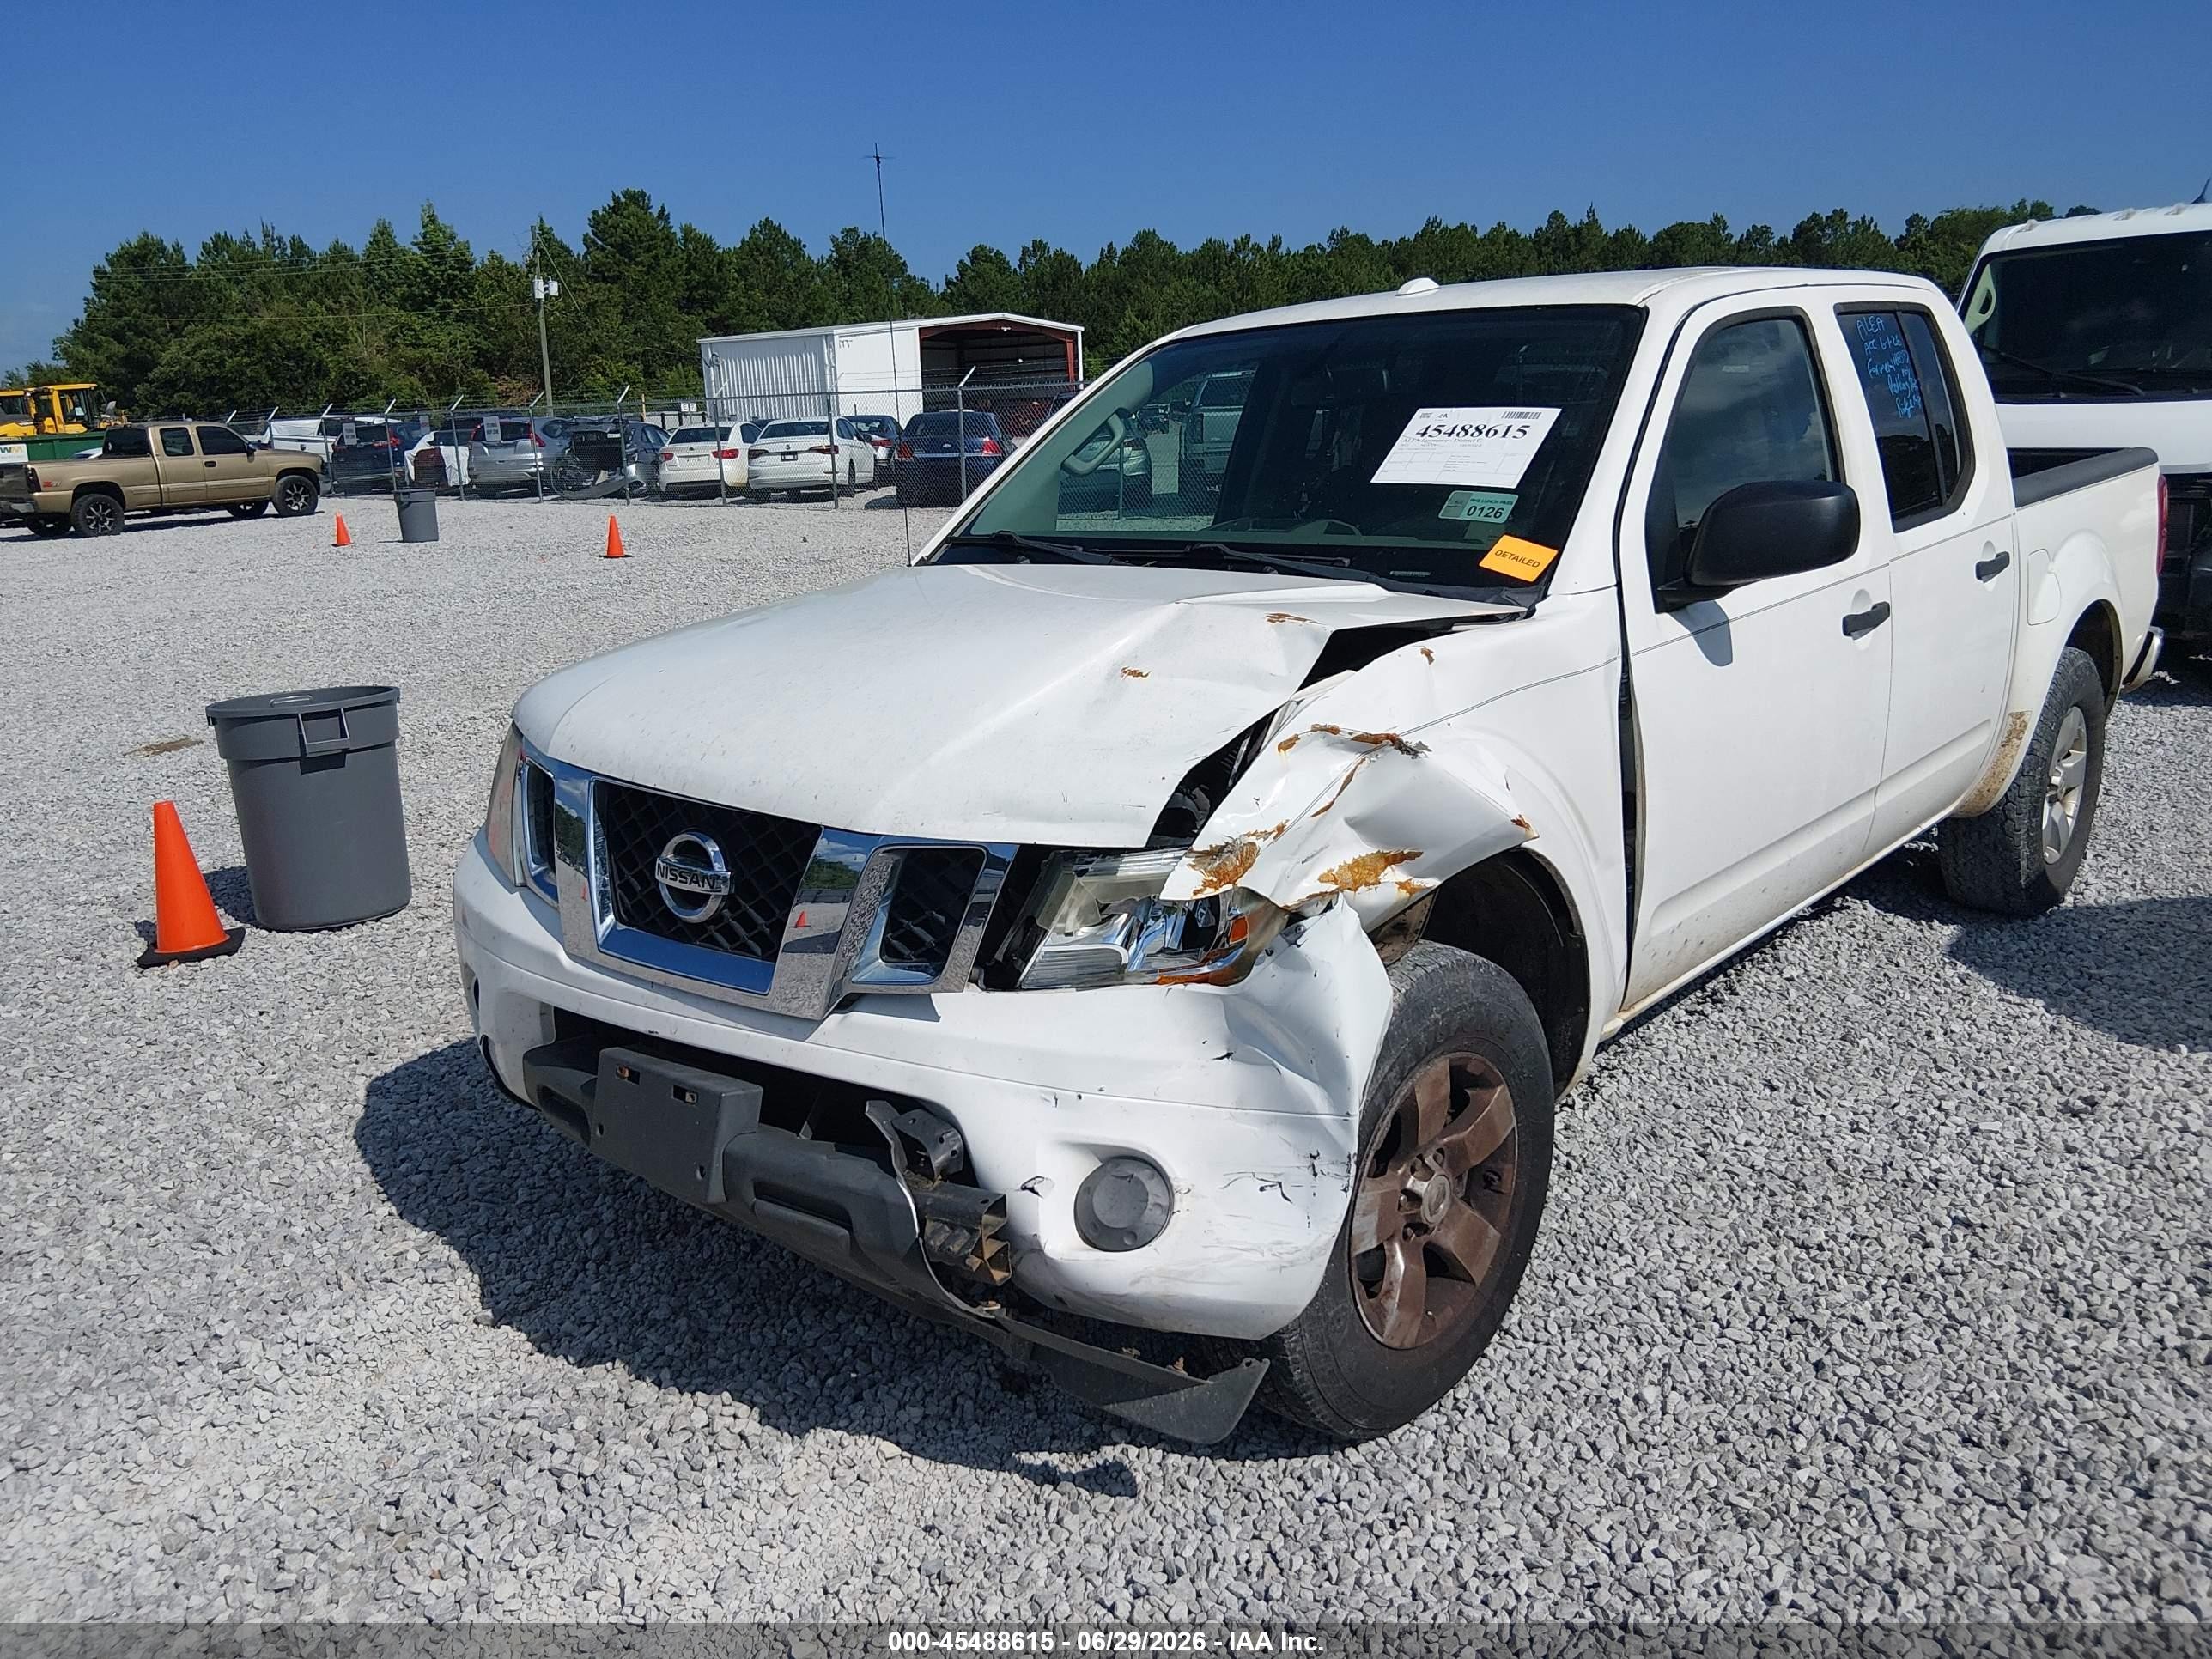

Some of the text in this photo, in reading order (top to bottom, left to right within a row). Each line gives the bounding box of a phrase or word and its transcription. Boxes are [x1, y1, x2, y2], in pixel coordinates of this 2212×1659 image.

[1415, 423, 1531, 440] 45488615
[1467, 506, 1504, 519] 0126
[1494, 550, 1540, 568] DETAILED
[657, 862, 716, 890] NISSAN
